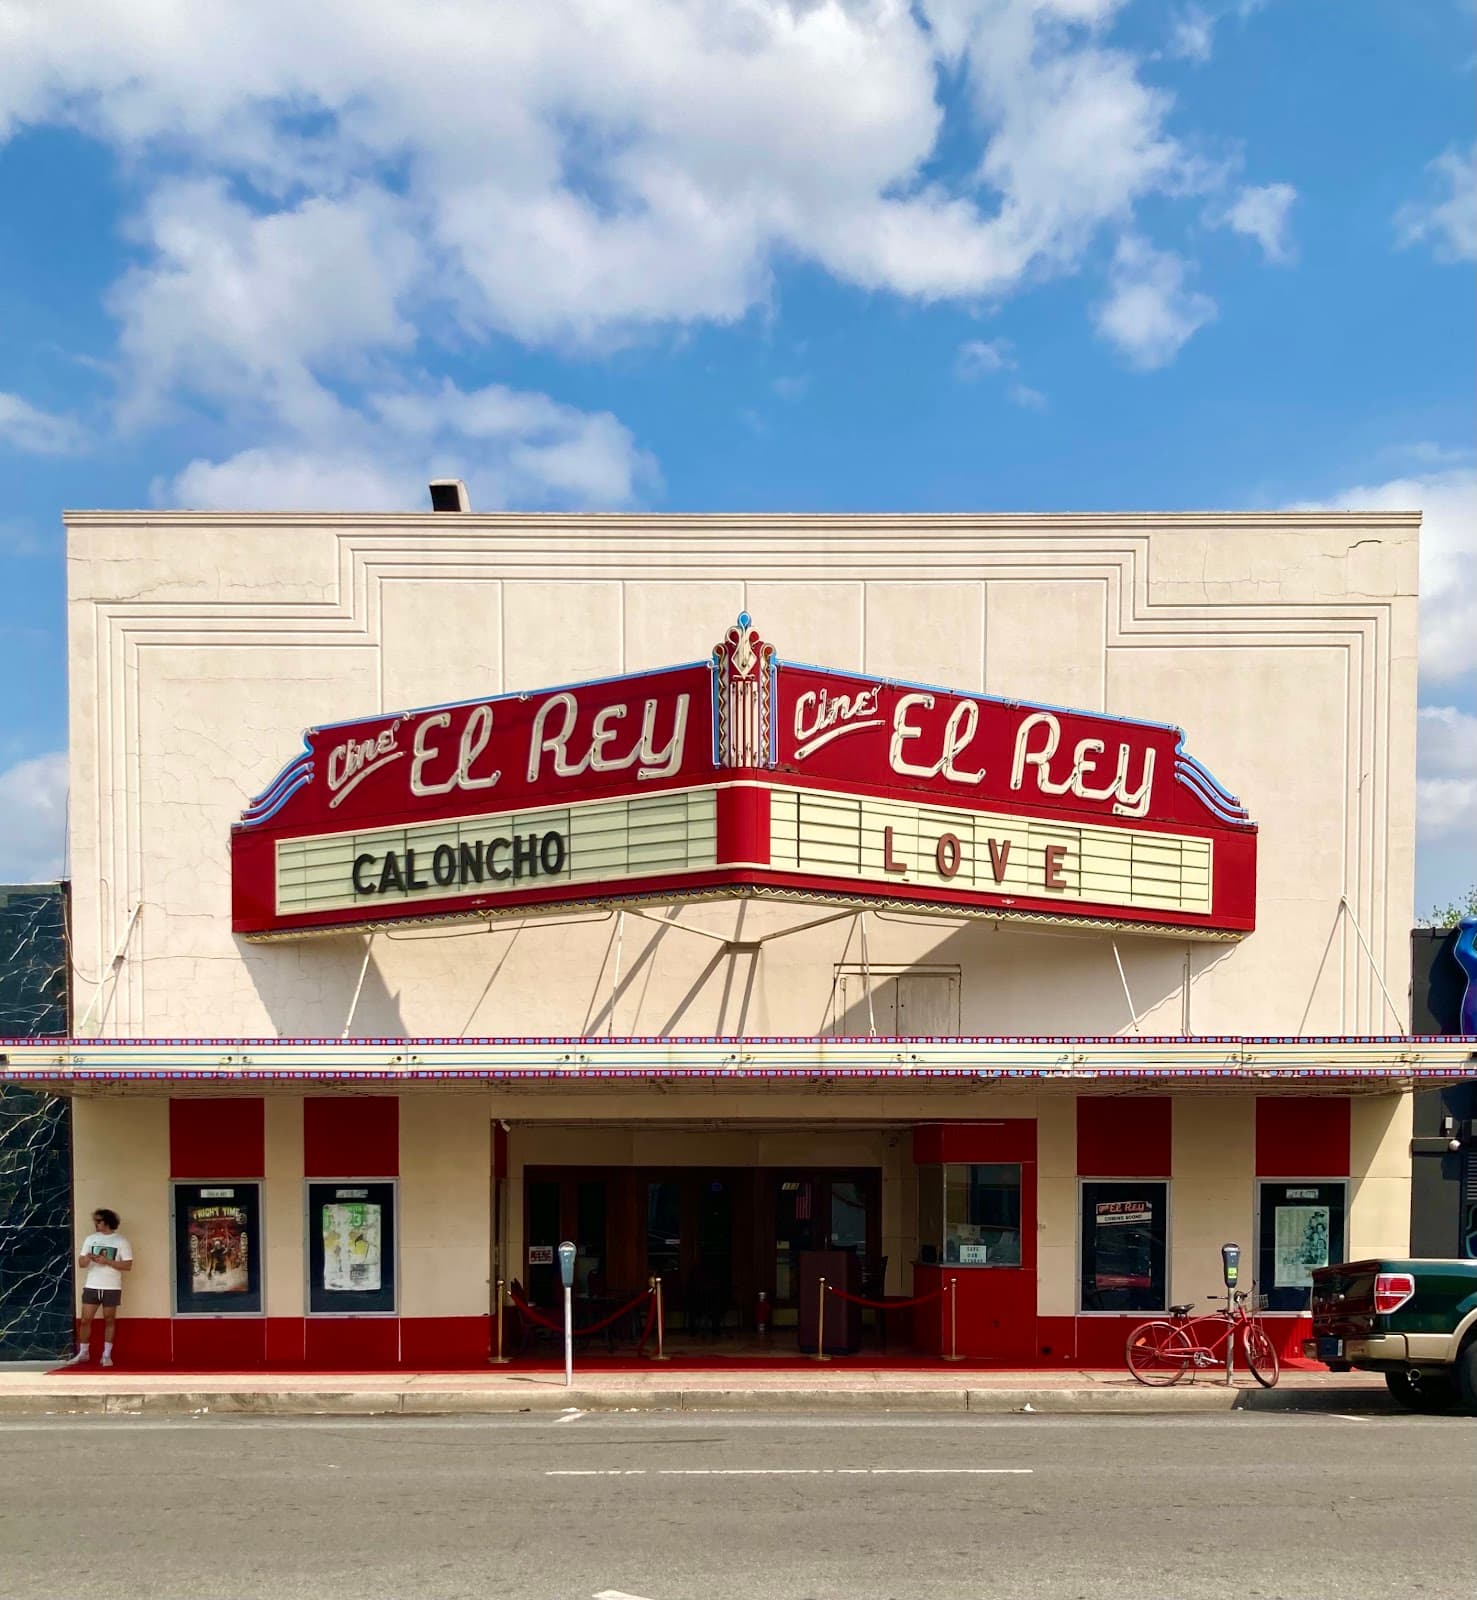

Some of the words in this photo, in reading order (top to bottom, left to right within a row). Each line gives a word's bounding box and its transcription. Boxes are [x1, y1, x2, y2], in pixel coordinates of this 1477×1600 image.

[410, 705, 501, 796] El
[527, 692, 690, 783] Rey
[889, 693, 986, 785] El
[1010, 712, 1156, 818] Rey
[352, 830, 566, 895] CALONCHO
[884, 825, 1067, 889] LOVE
